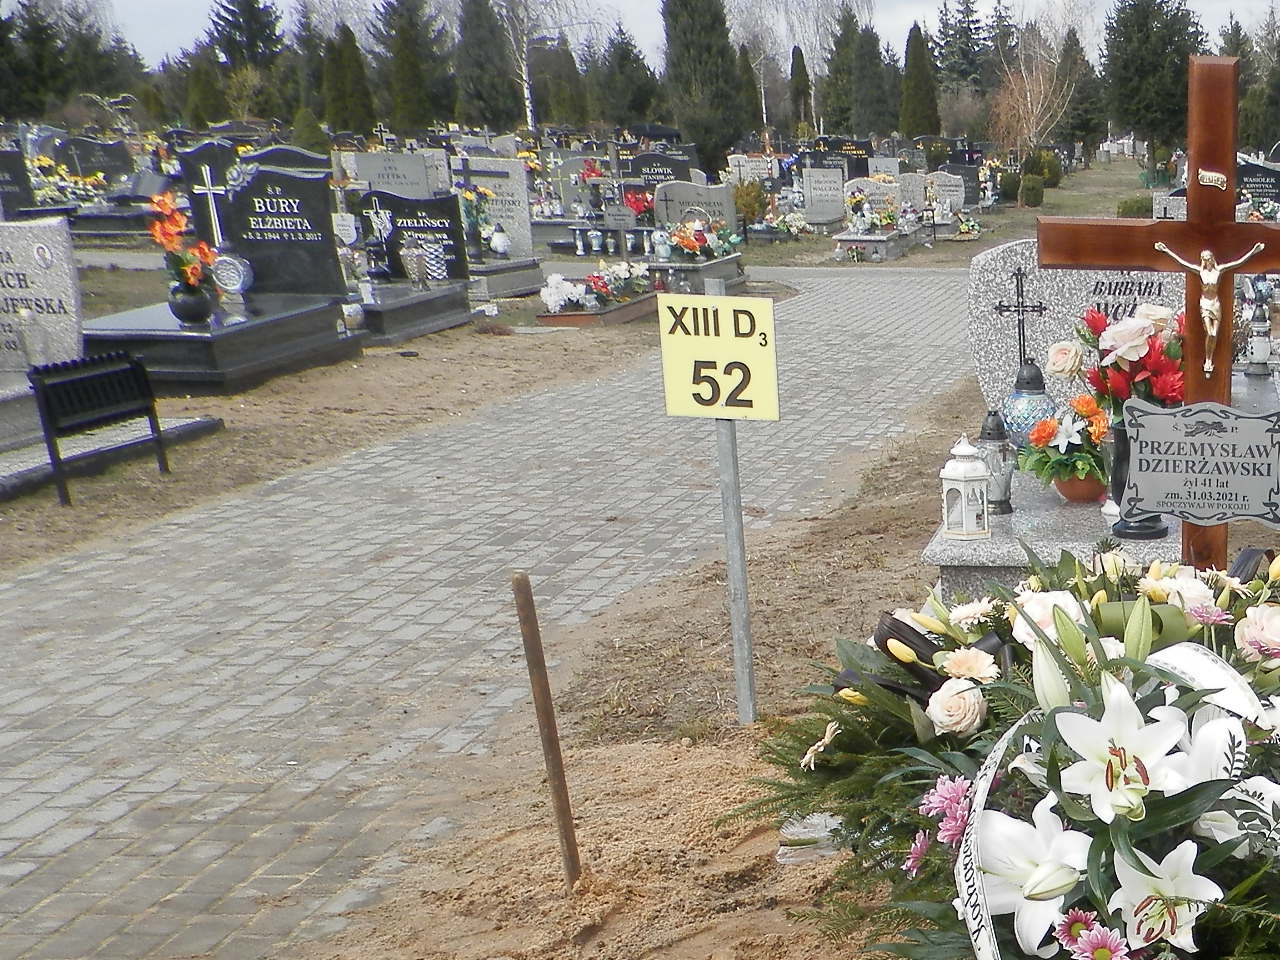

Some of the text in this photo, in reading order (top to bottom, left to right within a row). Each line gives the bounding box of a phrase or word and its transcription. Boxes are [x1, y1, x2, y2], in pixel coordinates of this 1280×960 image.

[253, 198, 300, 213] BURY
[248, 215, 312, 230] ELŻBIETA
[1093, 281, 1162, 296] BARBARA
[667, 306, 720, 337] XIII
[692, 360, 754, 409] 52
[1138, 440, 1273, 459] PRZEMYSŁAW
[1138, 457, 1271, 477] DZIERŻAWSKI
[1201, 478, 1213, 487] 41
[1216, 478, 1229, 488] lat
[1185, 491, 1239, 501] 31.03.2021
[1156, 501, 1250, 511] SPOCZYWAJ W POKOJU
